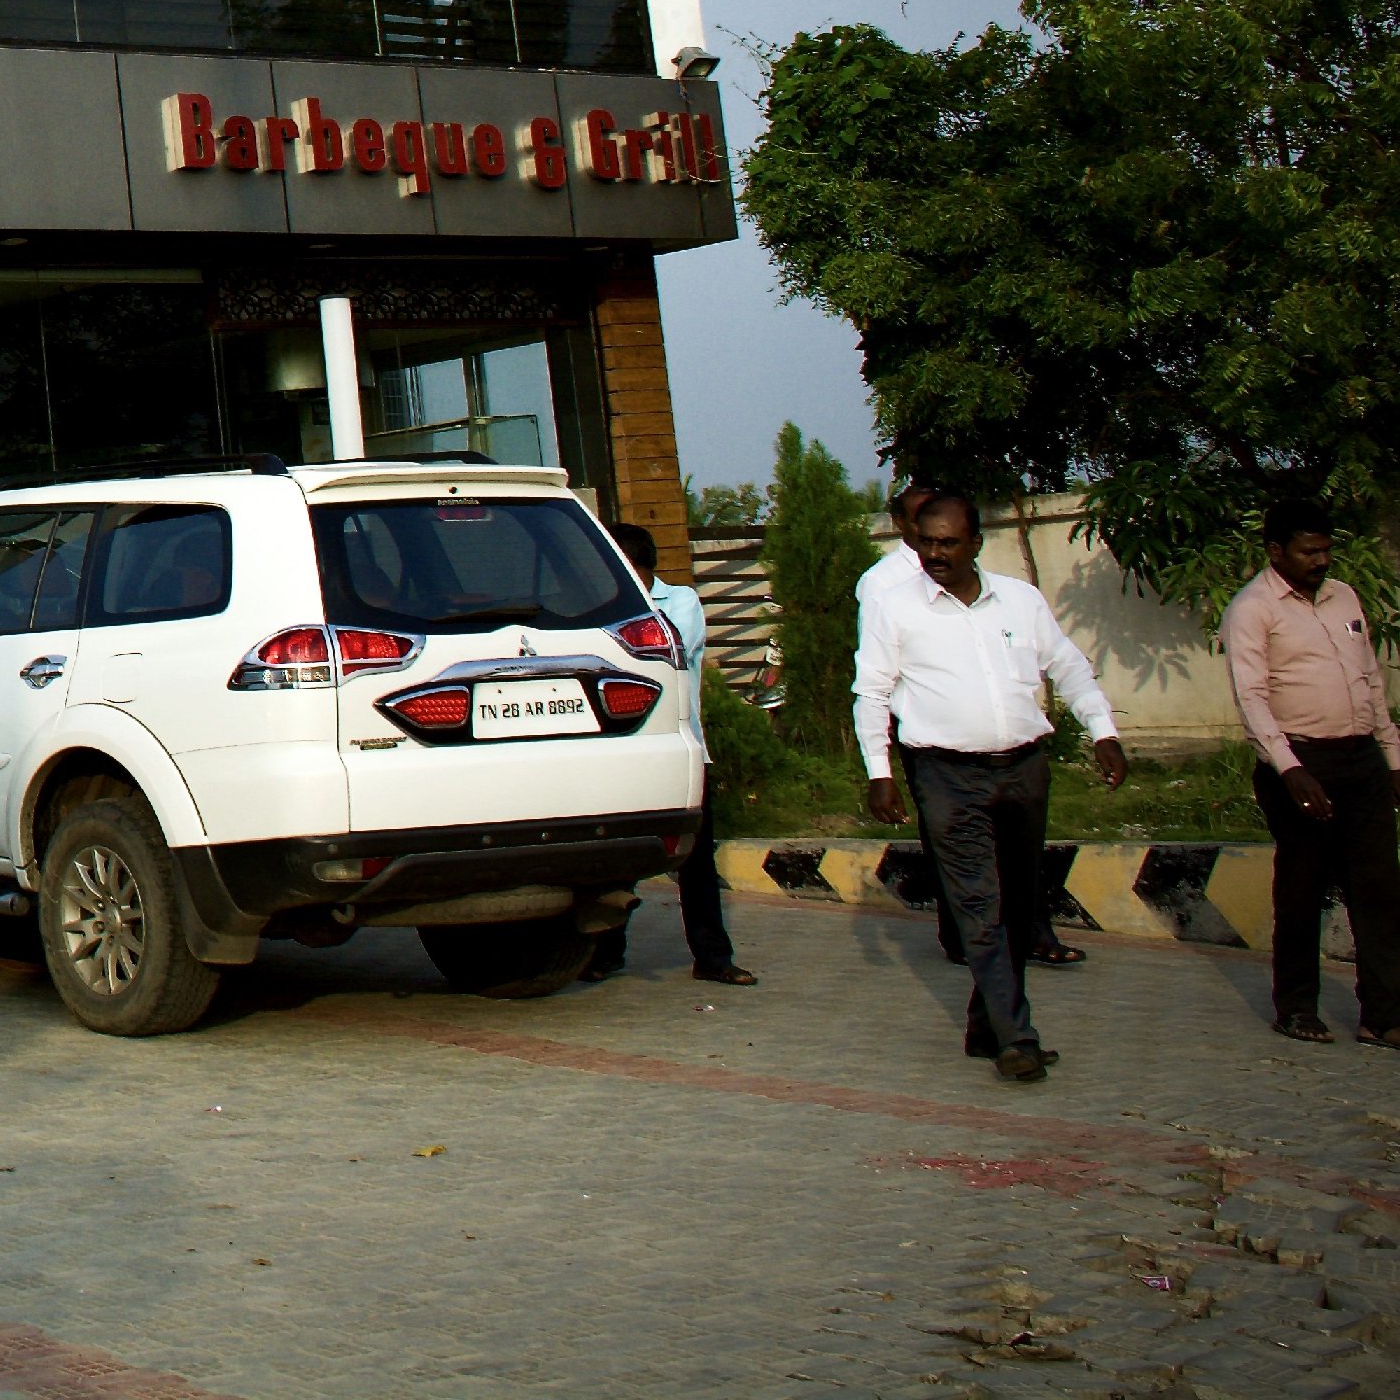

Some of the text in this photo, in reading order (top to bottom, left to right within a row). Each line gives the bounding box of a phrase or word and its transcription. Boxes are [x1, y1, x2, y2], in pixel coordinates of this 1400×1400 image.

[171, 93, 720, 196] Barbeque & Grill
[479, 705, 497, 719] TN
